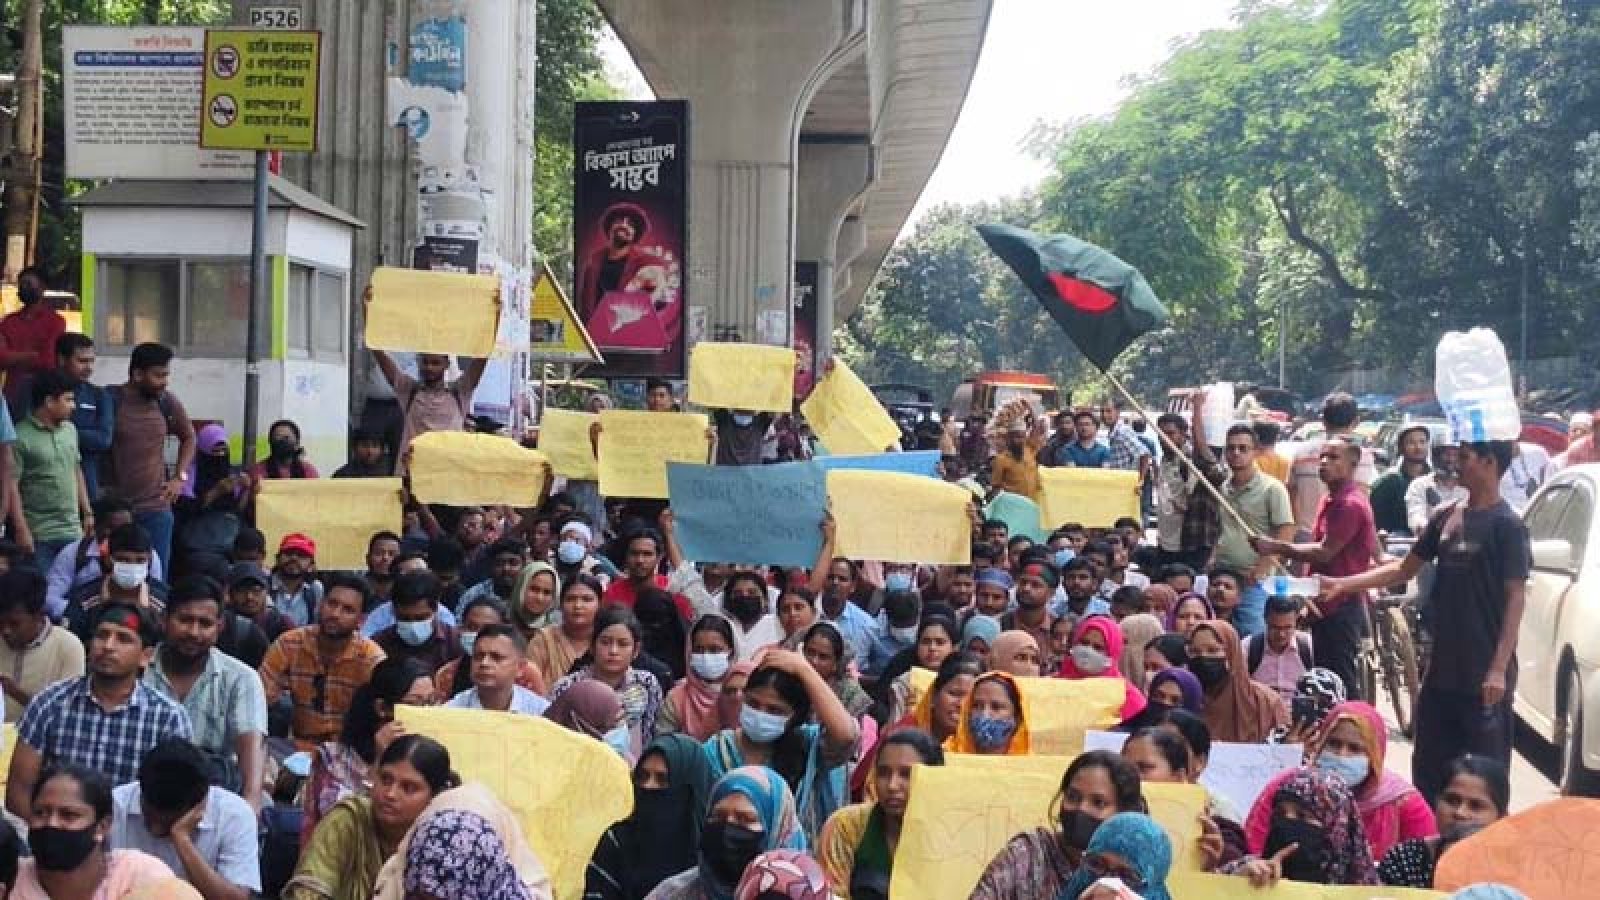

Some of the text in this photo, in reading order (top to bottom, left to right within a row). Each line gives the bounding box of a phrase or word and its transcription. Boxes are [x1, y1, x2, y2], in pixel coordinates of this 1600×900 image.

[252, 11, 299, 27] P526
[585, 149, 629, 172] বিকাশ
[609, 162, 660, 191] সম্ভব
